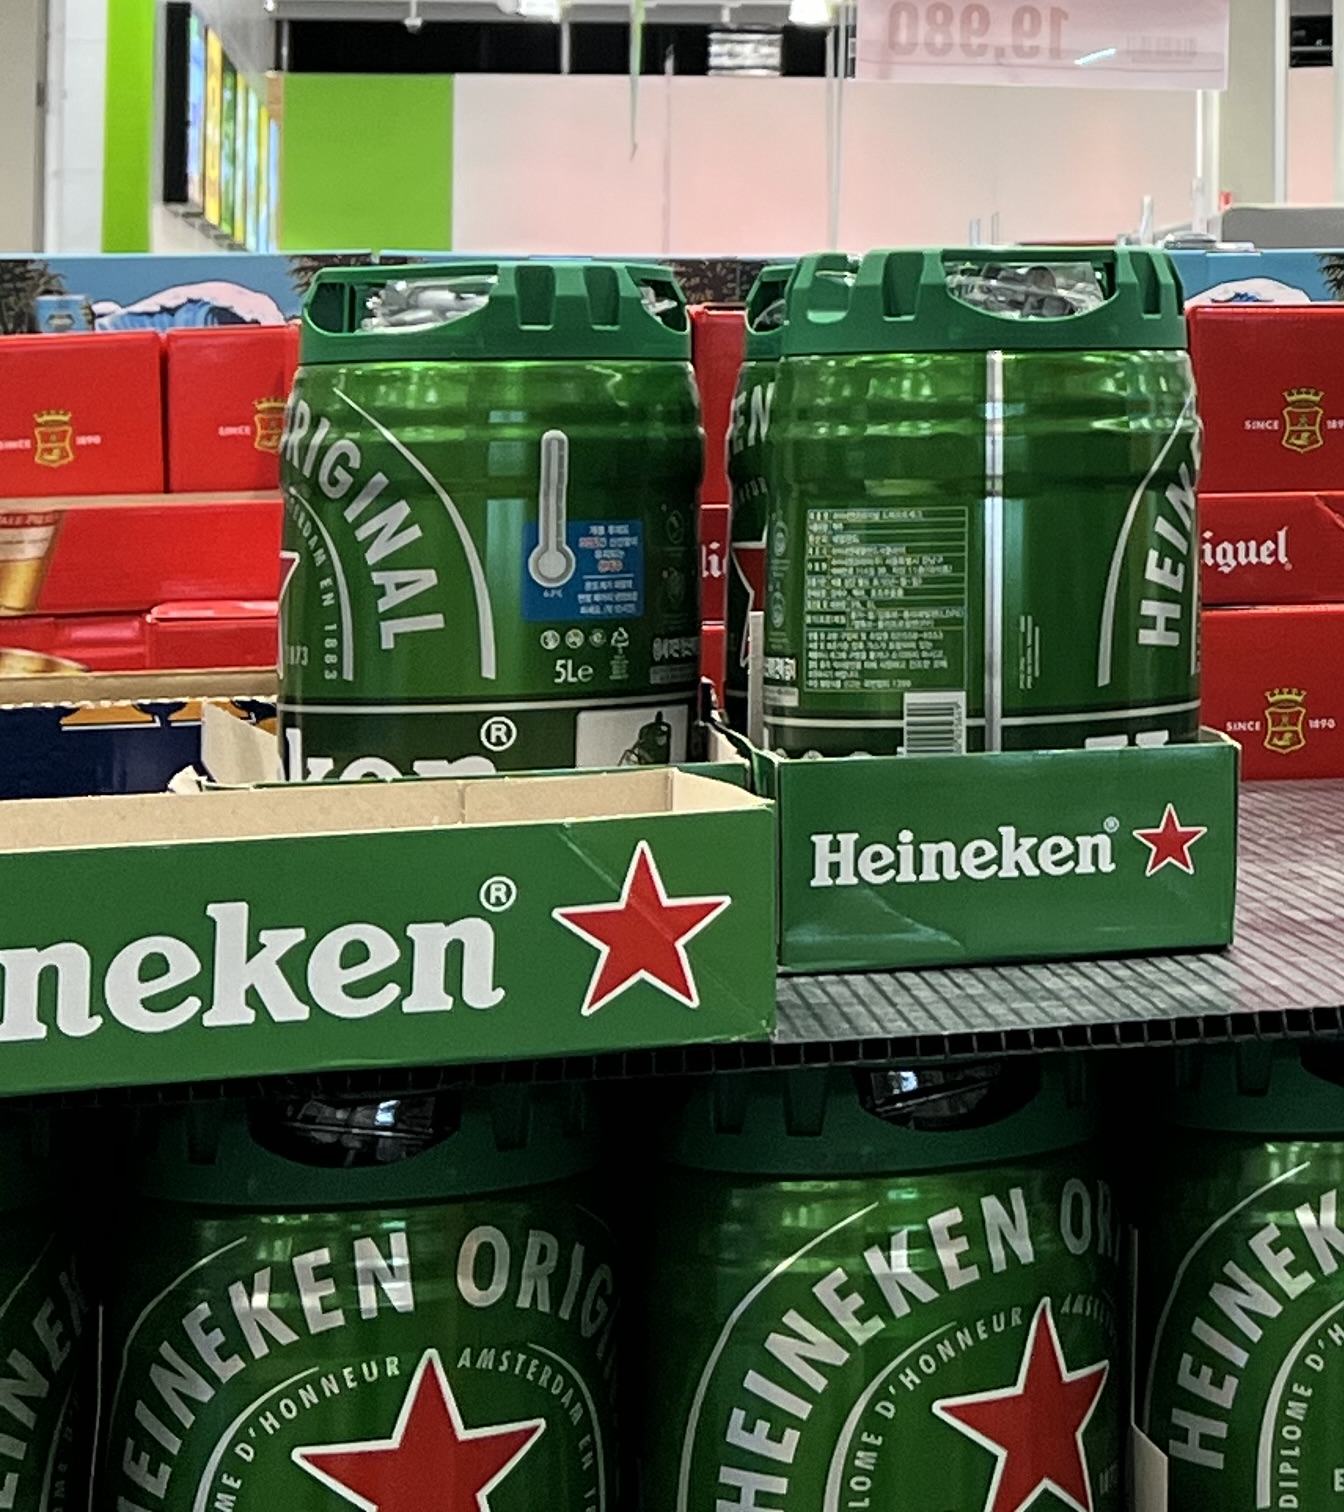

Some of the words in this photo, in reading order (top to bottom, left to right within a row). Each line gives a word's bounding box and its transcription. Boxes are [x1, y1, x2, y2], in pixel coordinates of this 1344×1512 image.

[1244, 419, 1279, 430] SINCE
[1226, 720, 1262, 733] SINCE
[1308, 718, 1336, 730] 1890
[1280, 1381, 1314, 1510] DIPLOME
